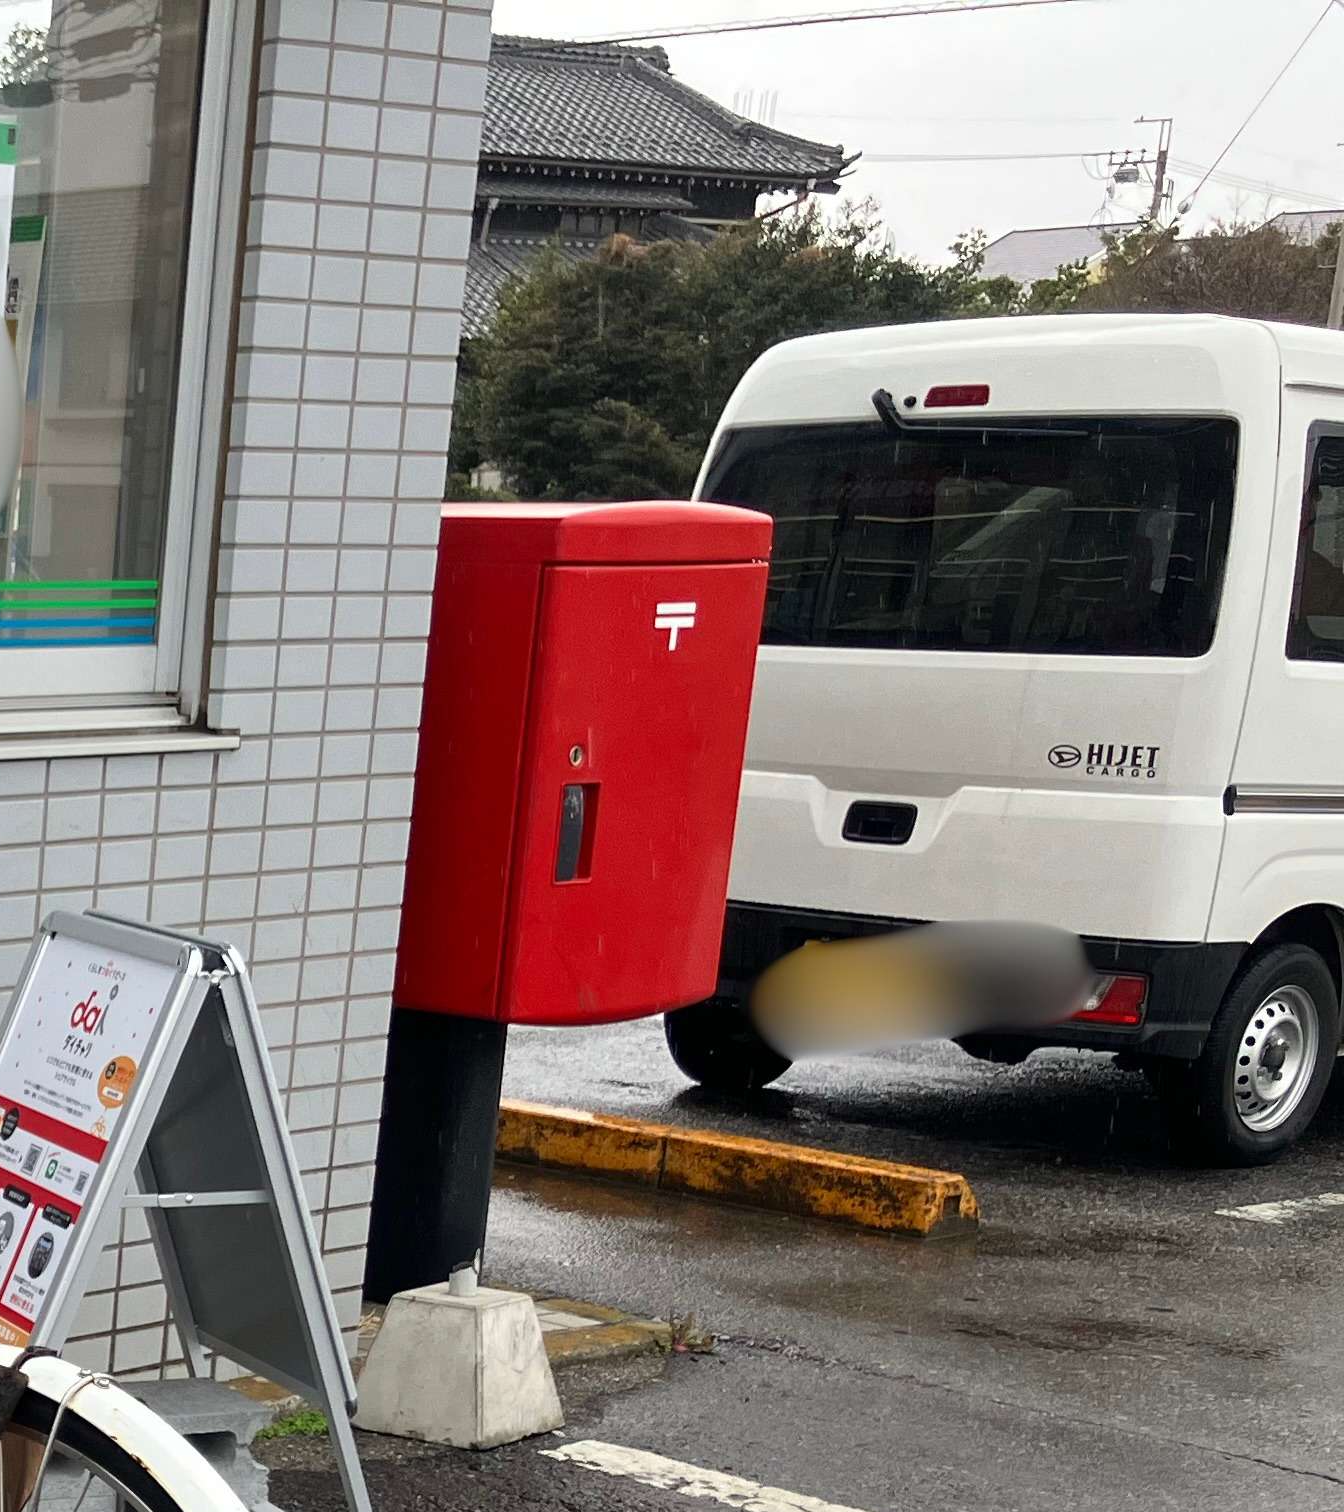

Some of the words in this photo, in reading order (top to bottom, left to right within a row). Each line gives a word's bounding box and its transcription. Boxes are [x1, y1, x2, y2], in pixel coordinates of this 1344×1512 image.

[1087, 743, 1160, 768] HIJET
[1086, 766, 1156, 778] CARGO
[62, 1034, 94, 1058] ダイチャリ
